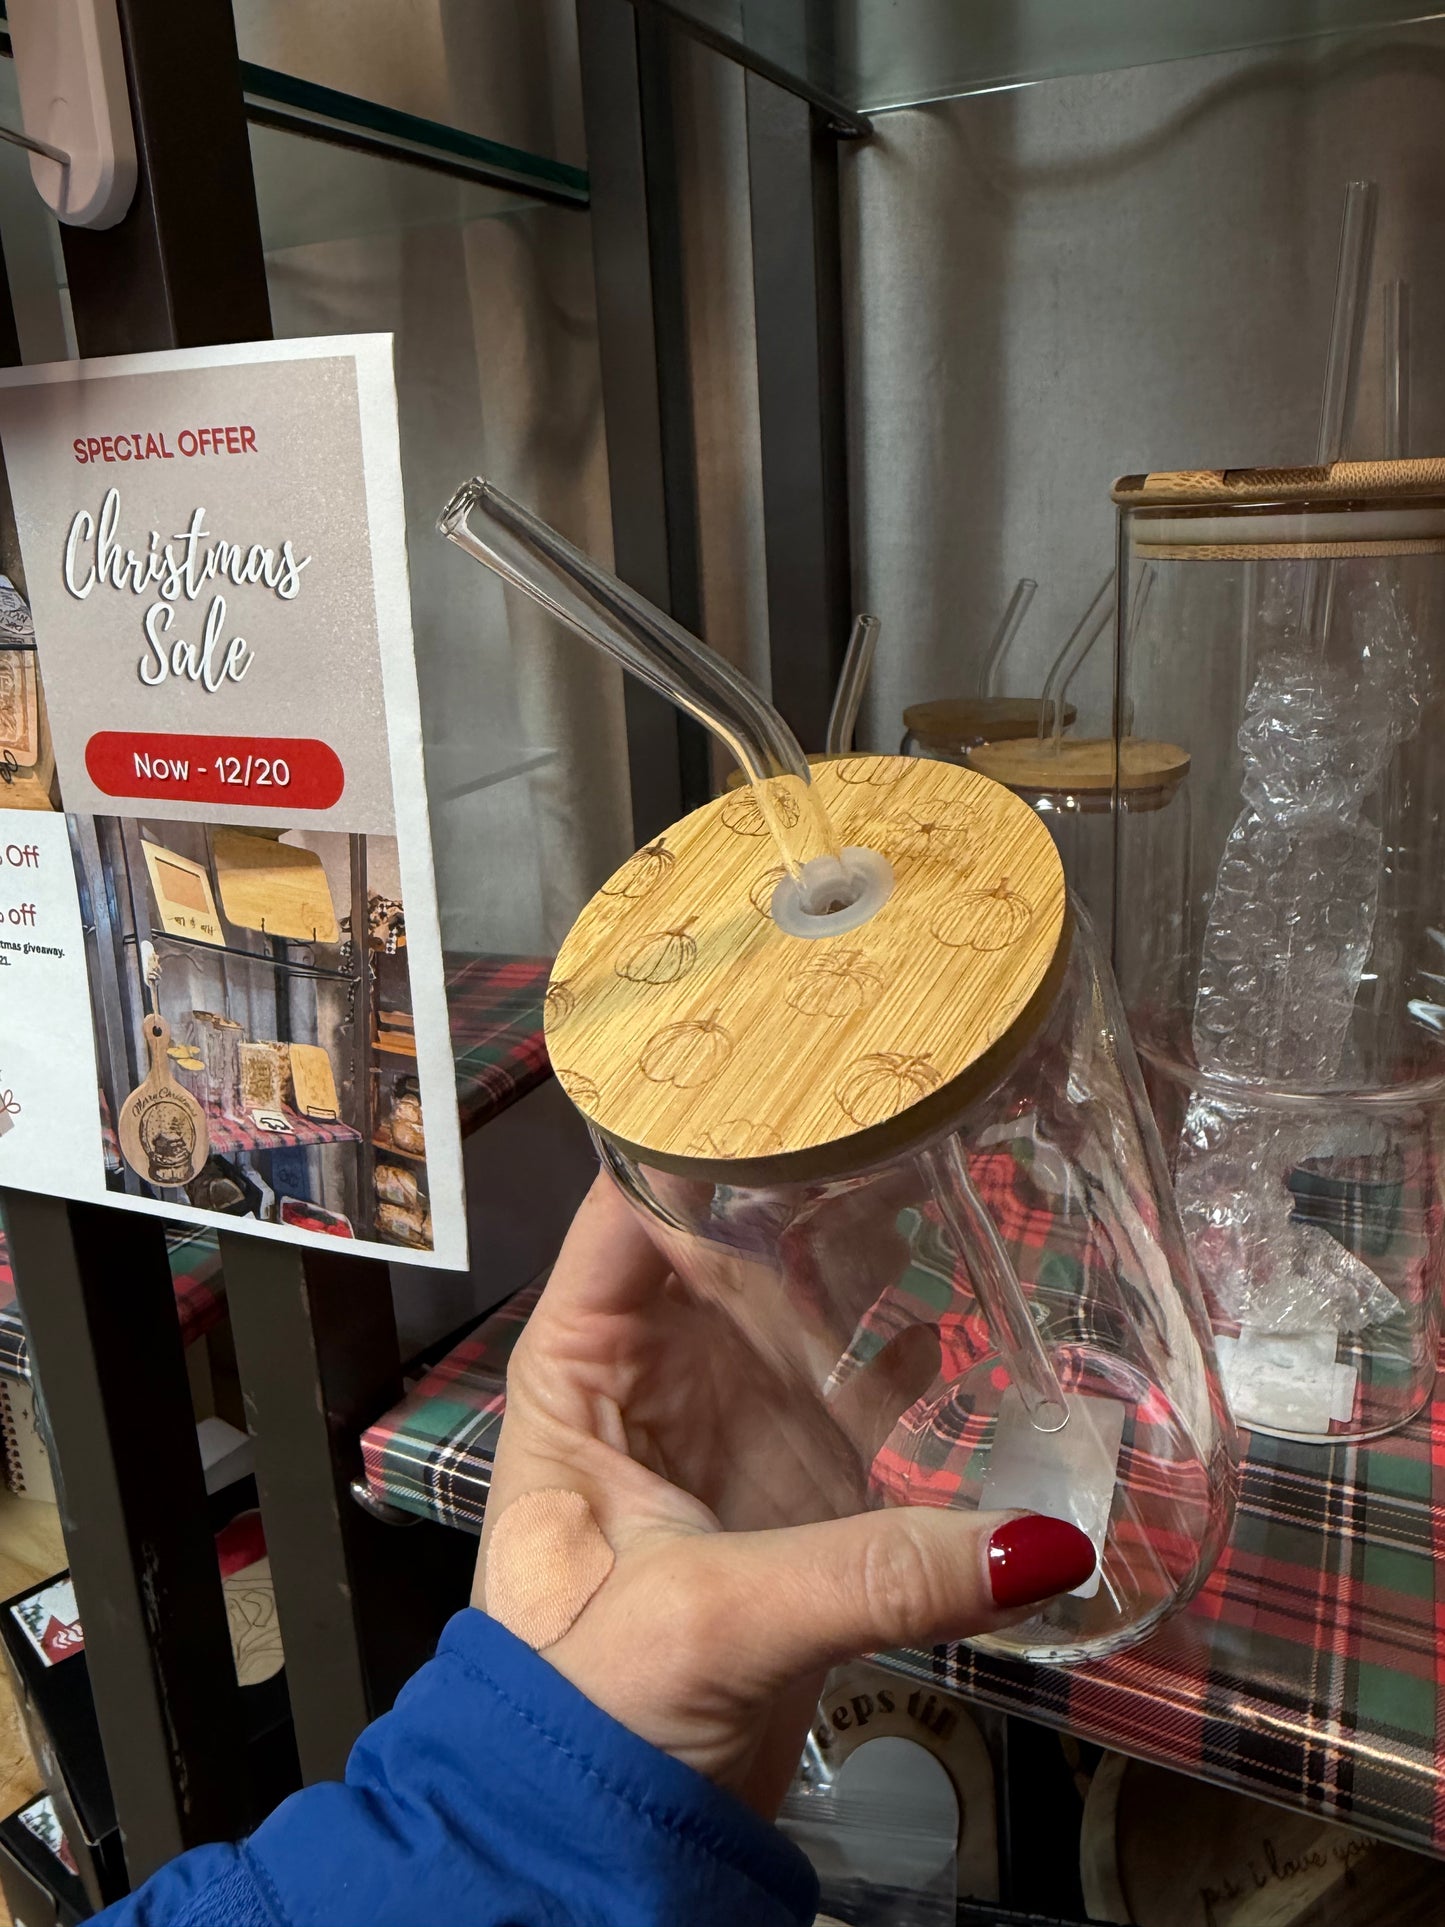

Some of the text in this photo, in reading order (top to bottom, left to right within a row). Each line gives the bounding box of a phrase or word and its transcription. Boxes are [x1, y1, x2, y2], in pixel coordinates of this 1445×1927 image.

[73, 425, 258, 464] SPECIAL OFFER
[64, 487, 312, 601] Christmas
[138, 594, 255, 693] Sale
[133, 752, 189, 780] Now
[214, 755, 291, 786] 12/20
[6, 844, 39, 868] Off
[8, 903, 37, 927] off
[23, 942, 66, 959] giveaway.
[816, 1690, 895, 1749] eeps
